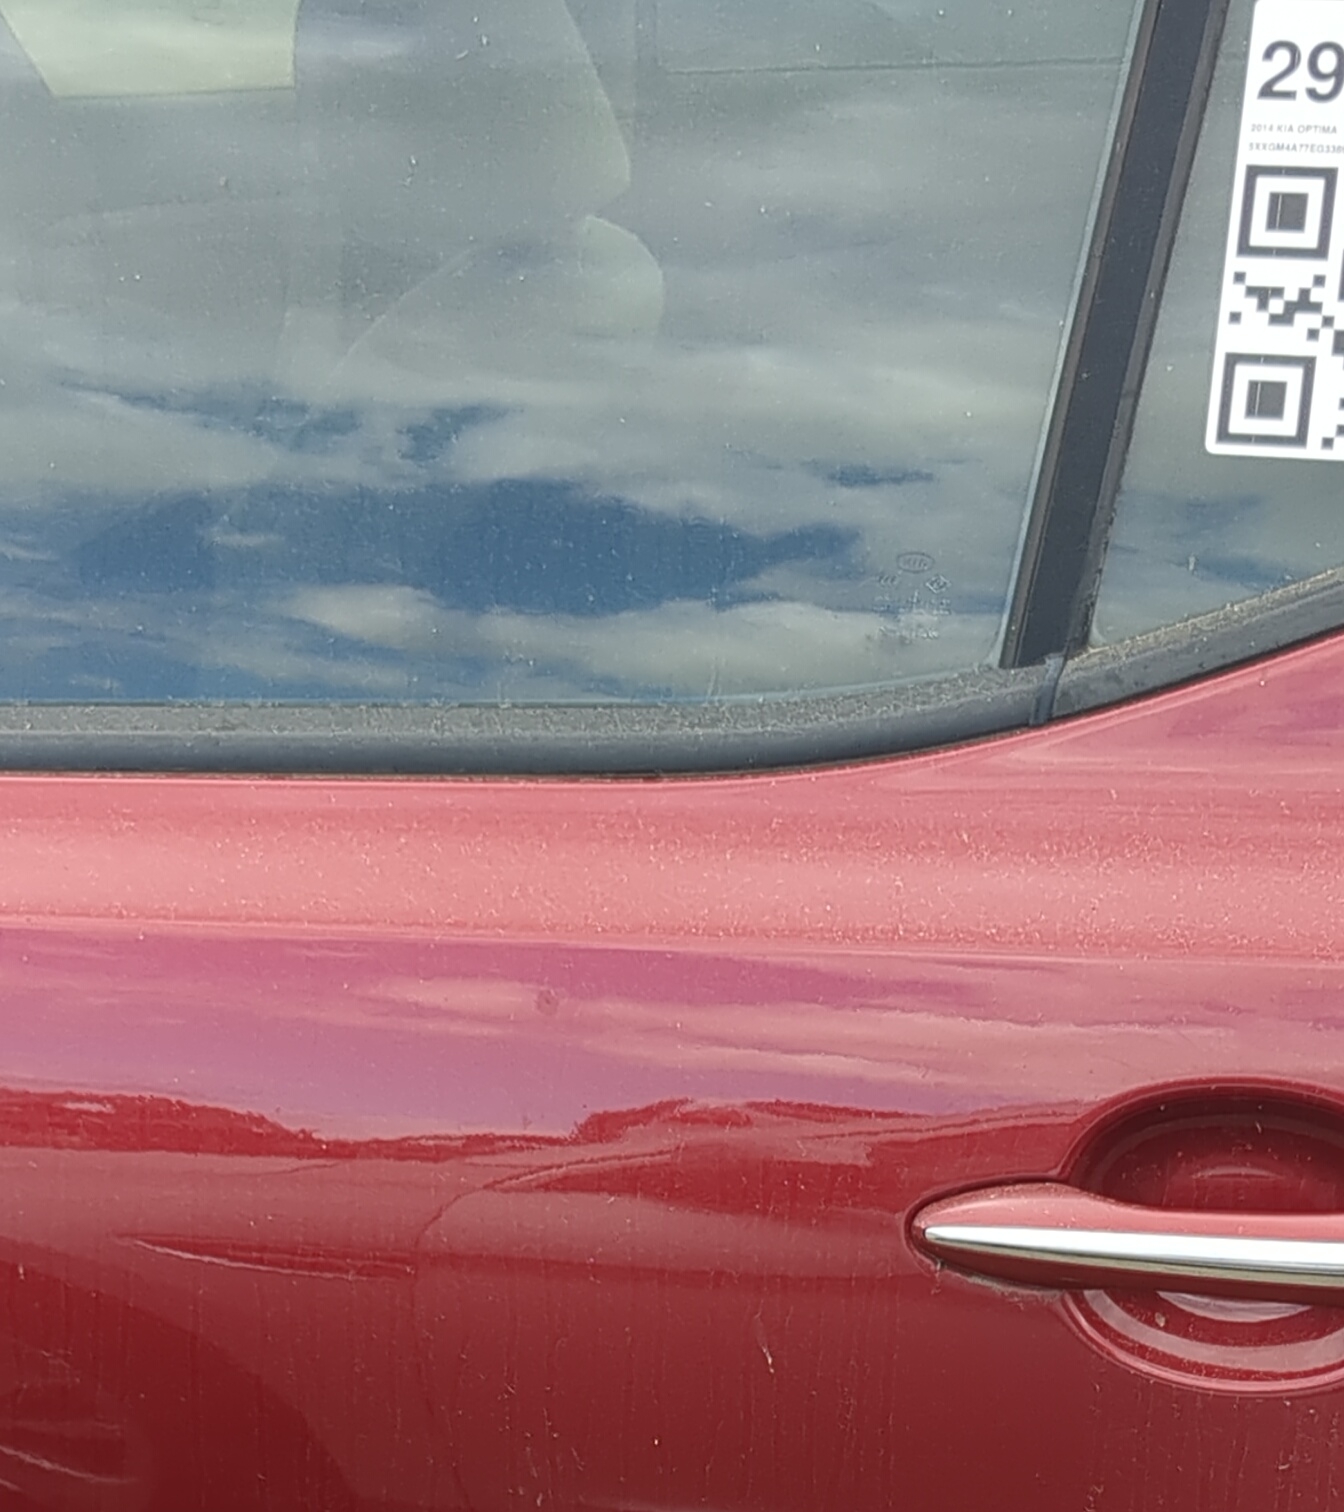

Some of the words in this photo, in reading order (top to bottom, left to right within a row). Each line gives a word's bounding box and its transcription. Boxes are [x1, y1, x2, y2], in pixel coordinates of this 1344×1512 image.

[1250, 123, 1274, 133] 2014
[1277, 124, 1294, 133] KIA
[1297, 125, 1338, 135] OPTIMA
